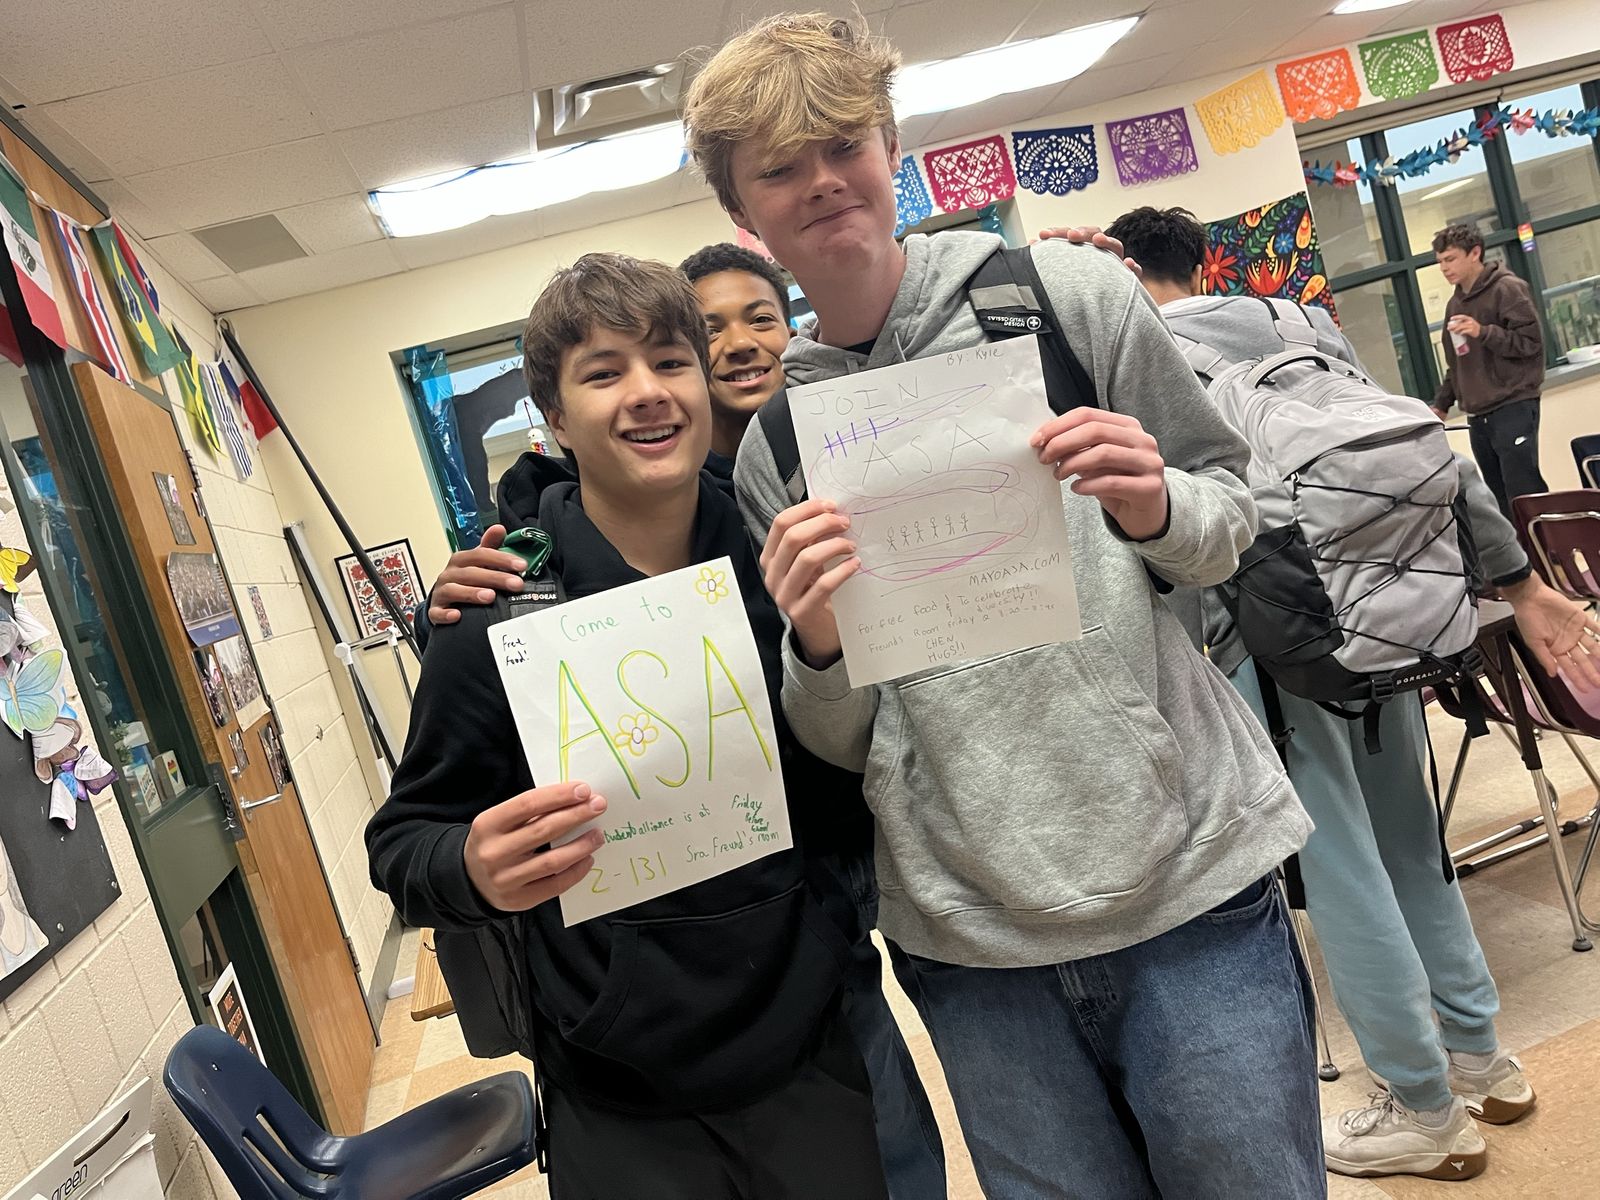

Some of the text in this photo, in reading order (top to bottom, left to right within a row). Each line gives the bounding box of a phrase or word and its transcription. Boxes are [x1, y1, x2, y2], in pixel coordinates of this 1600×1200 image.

[975, 348, 1004, 360] Kyle
[803, 376, 919, 416] JOIN
[861, 423, 993, 486] ASA
[560, 596, 673, 642] Come to
[1396, 669, 1442, 685] BOREALIS
[558, 635, 773, 800] ASA
[684, 811, 693, 823] is
[698, 803, 711, 818] at
